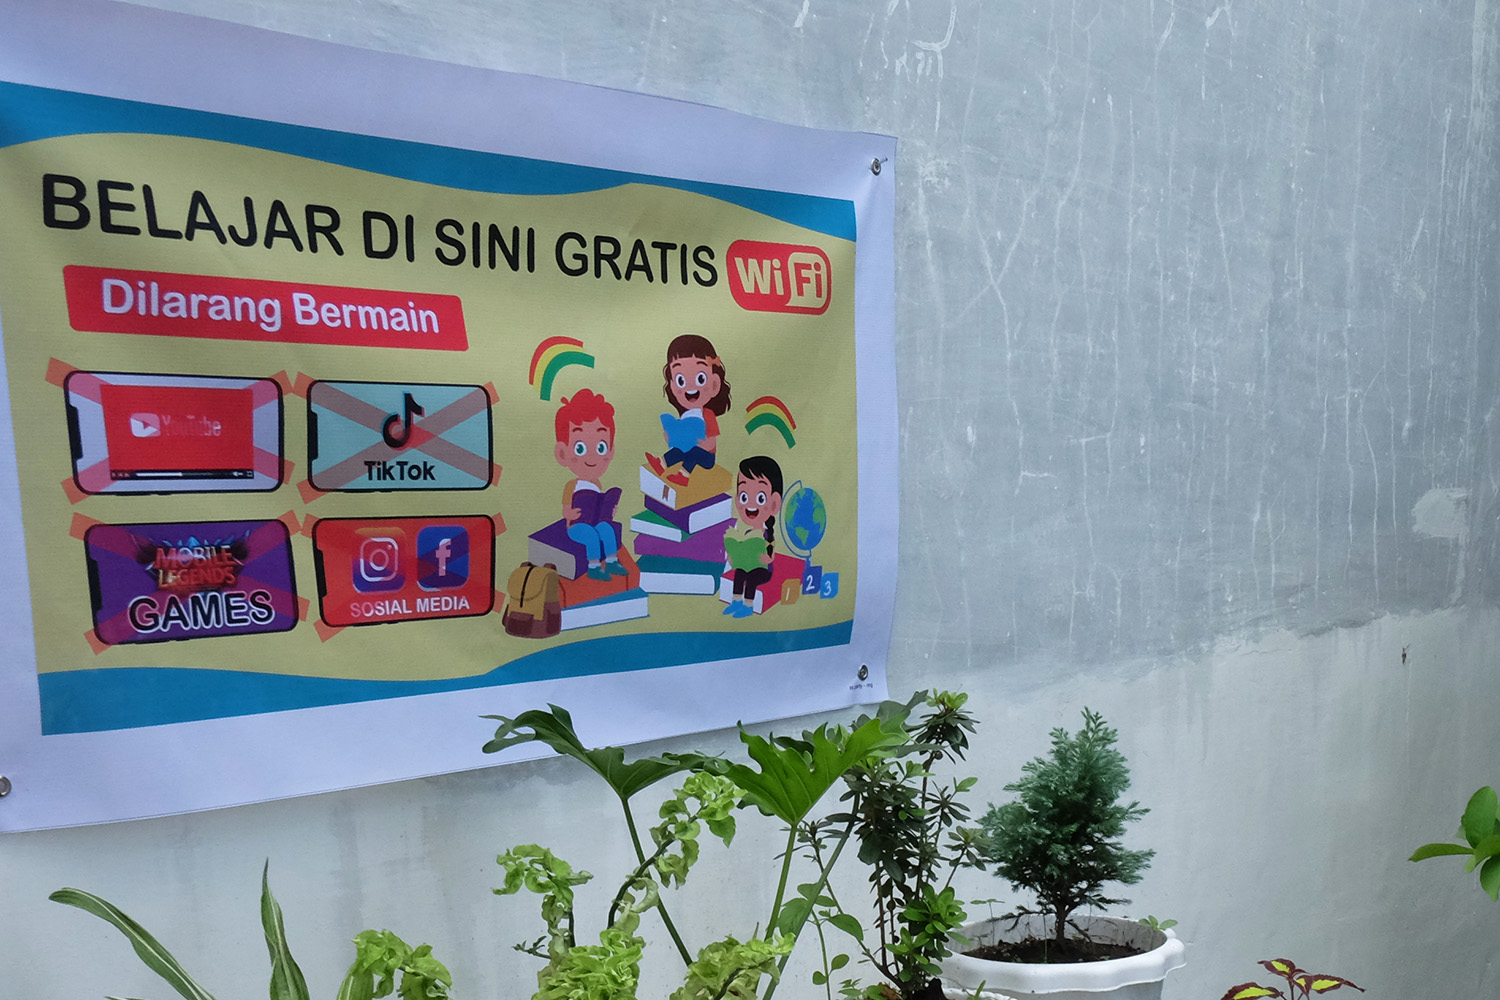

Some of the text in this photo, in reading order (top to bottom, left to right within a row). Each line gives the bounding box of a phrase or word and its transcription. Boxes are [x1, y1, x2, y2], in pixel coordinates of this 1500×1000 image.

[42, 173, 344, 256] BELAJAR
[363, 210, 415, 263] DI
[435, 218, 535, 274] SINI
[555, 231, 718, 288] GRATIS
[102, 278, 440, 334] Dilarang Bermain
[364, 460, 436, 481] TikTok
[153, 546, 237, 571] MOBILE
[157, 567, 237, 588] LEGENDS
[128, 589, 276, 634] GAMES
[350, 595, 471, 618] SOSIAL MEDIA
